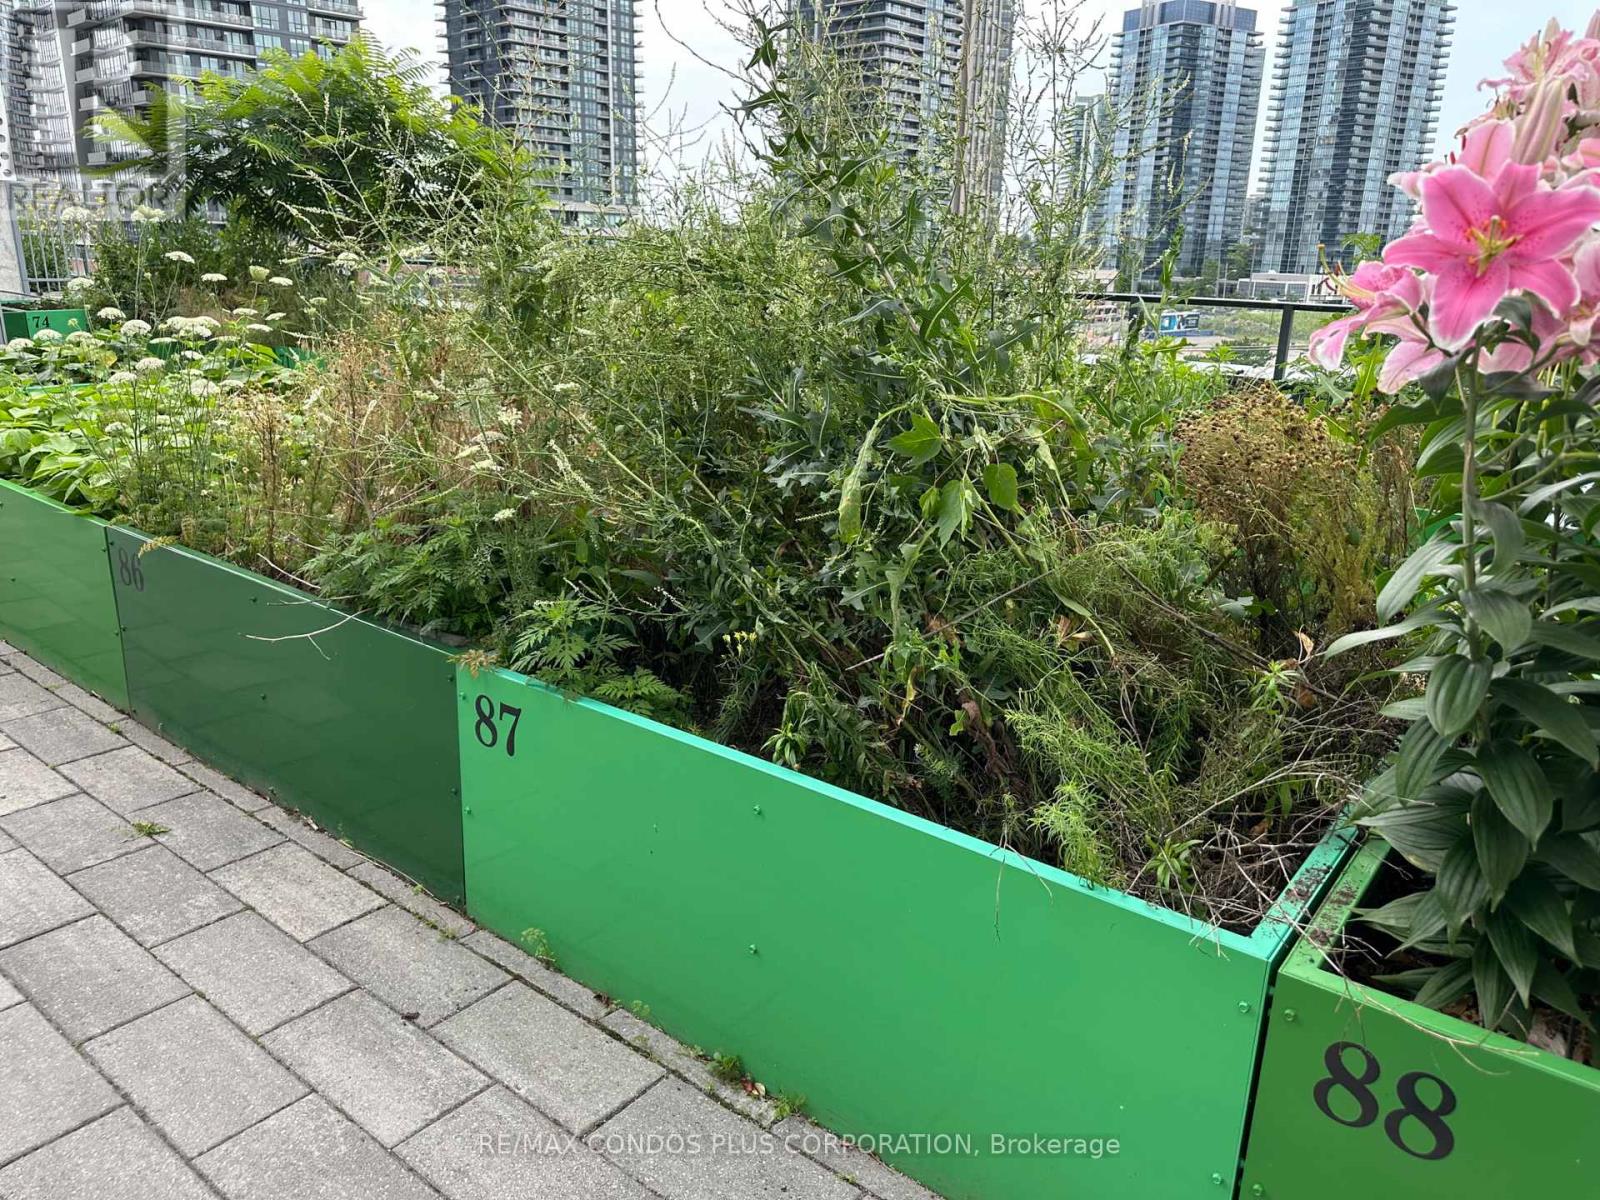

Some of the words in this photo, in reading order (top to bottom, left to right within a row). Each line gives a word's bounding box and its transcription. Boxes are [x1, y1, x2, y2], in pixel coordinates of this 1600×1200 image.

[32, 316, 50, 328] 74
[118, 547, 145, 592] 86
[474, 694, 522, 757] 87
[1313, 1041, 1457, 1160] 88
